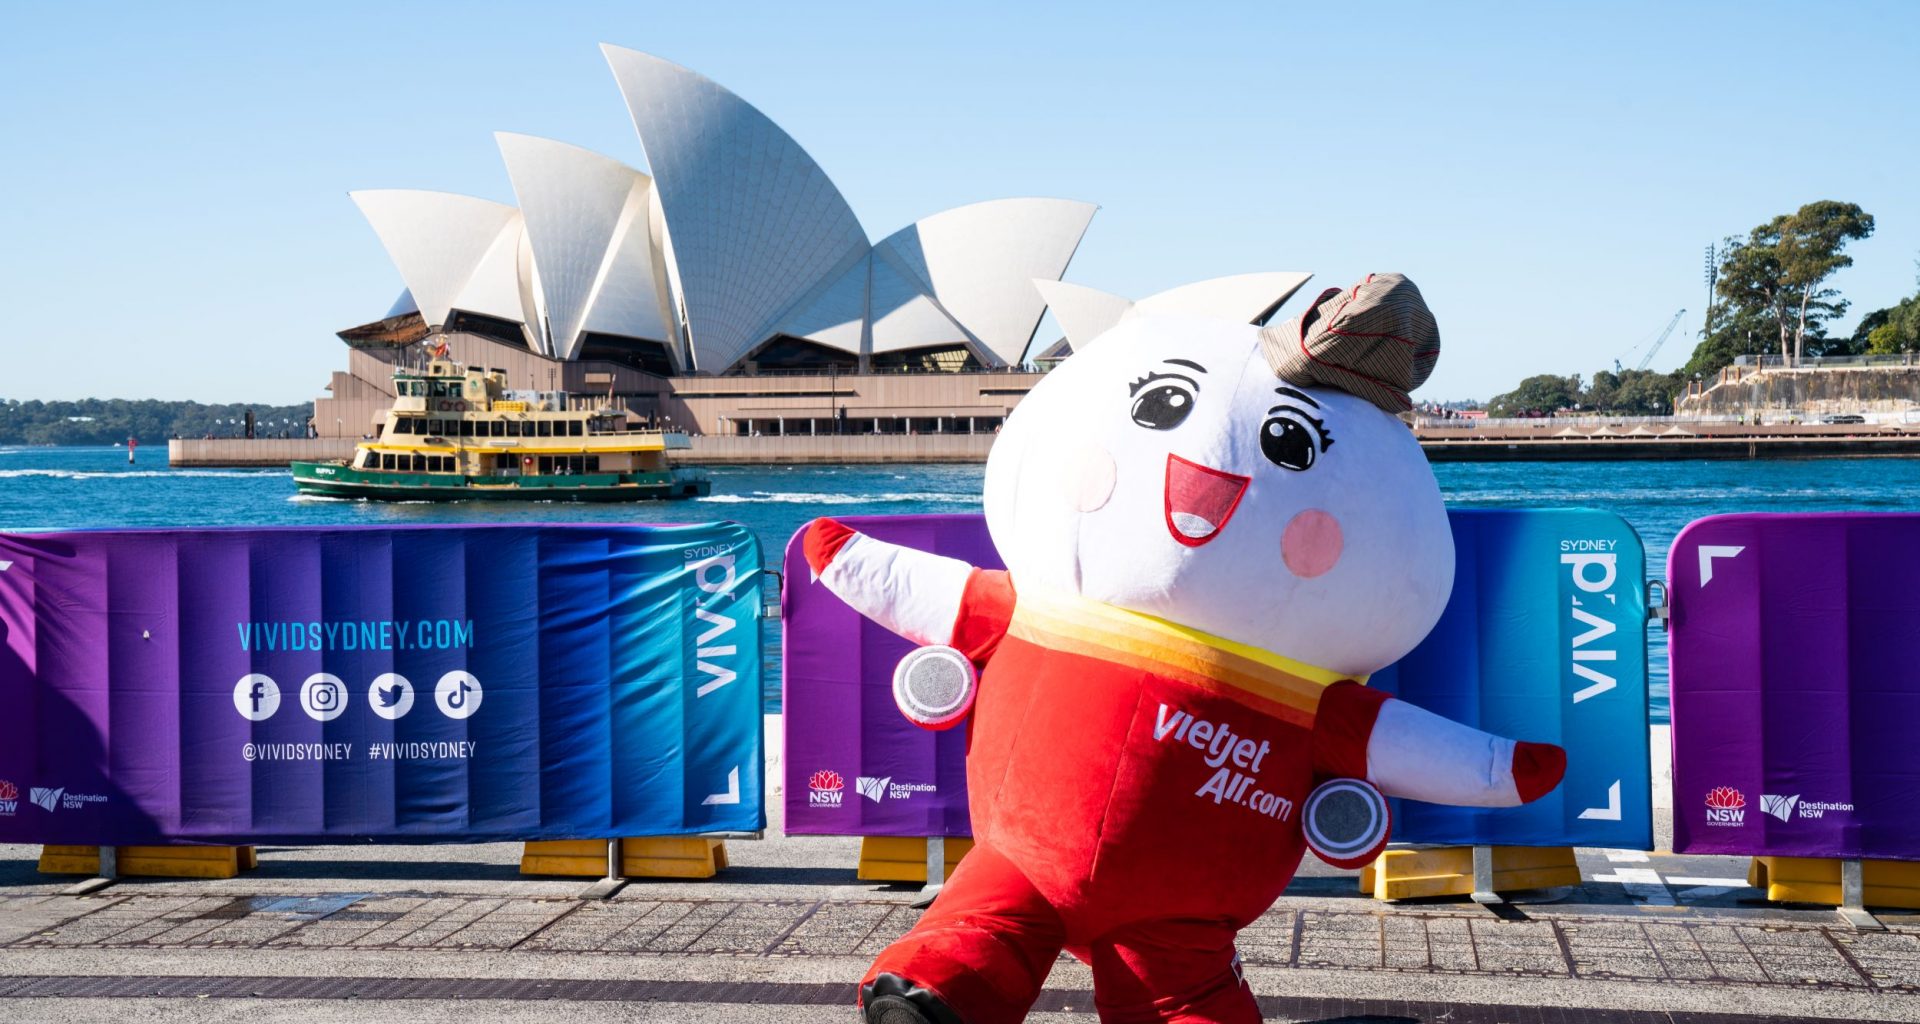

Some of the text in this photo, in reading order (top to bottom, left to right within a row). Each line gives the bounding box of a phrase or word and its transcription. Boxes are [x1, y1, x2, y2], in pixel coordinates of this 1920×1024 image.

[684, 543, 736, 558] SYDNEY
[1560, 539, 1617, 551] SYDNEY
[237, 619, 474, 651] VIVIDSYDNEY.COM
[242, 741, 476, 762] @VIVIDSYDNEY #VIVIDSYDNEY
[890, 782, 937, 792] Destination
[63, 793, 108, 802] Destination
[809, 791, 842, 803] NSW
[889, 791, 910, 799] NSW
[63, 801, 83, 809] NSW
[1799, 801, 1854, 811] Destination
[1706, 809, 1745, 821] NSW
[1799, 810, 1824, 818] NSW
